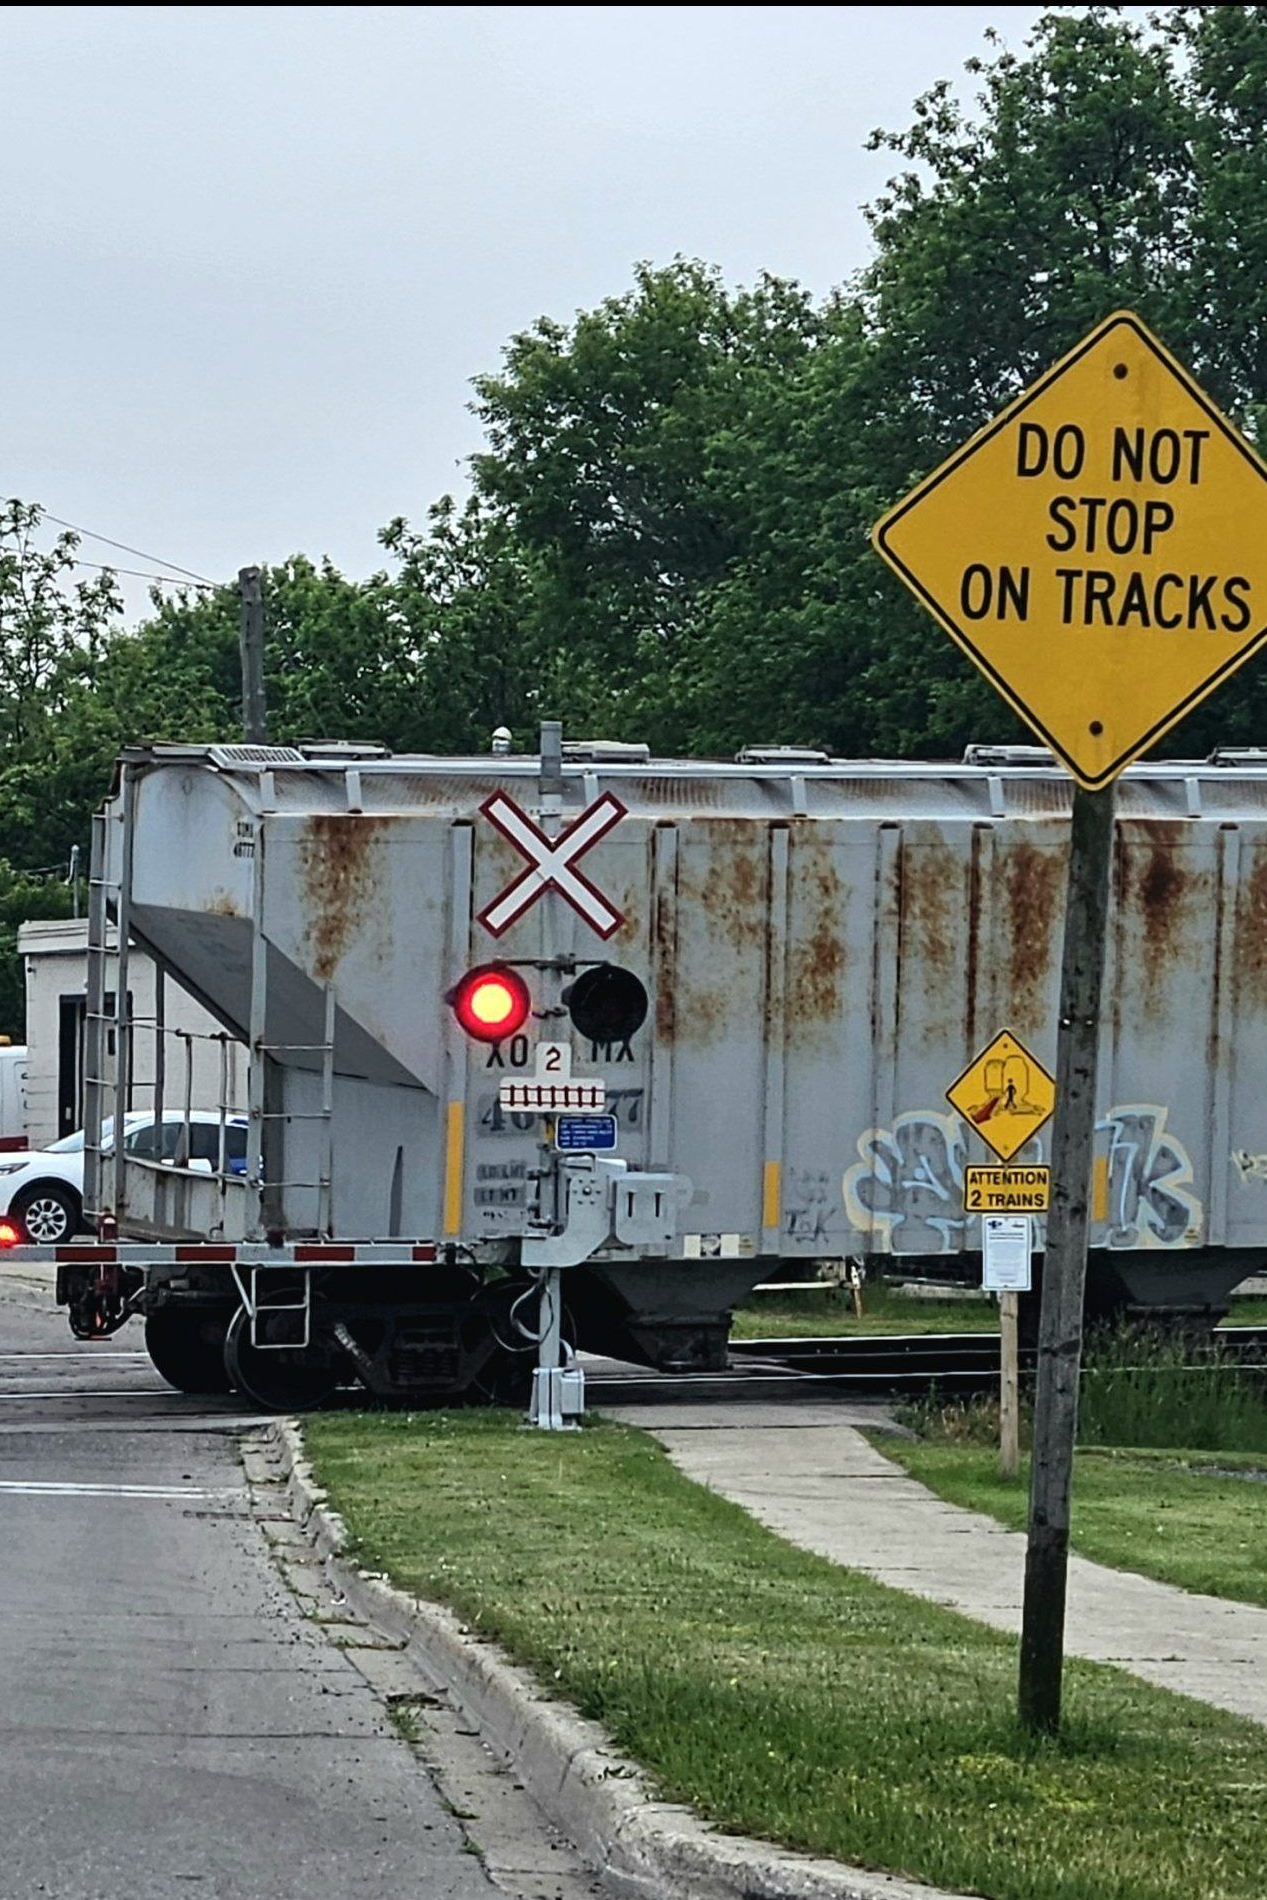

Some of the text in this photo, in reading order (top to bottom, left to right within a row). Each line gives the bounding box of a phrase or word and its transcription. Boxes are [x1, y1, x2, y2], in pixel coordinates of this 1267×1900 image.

[1016, 422, 1210, 485] DO NOT
[1046, 496, 1174, 555] STOP
[961, 563, 1251, 633] ON TRACKS
[545, 1046, 561, 1071] 2
[969, 1171, 1047, 1185] ATTENTION
[970, 1189, 1045, 1207] 2 TRAINS
